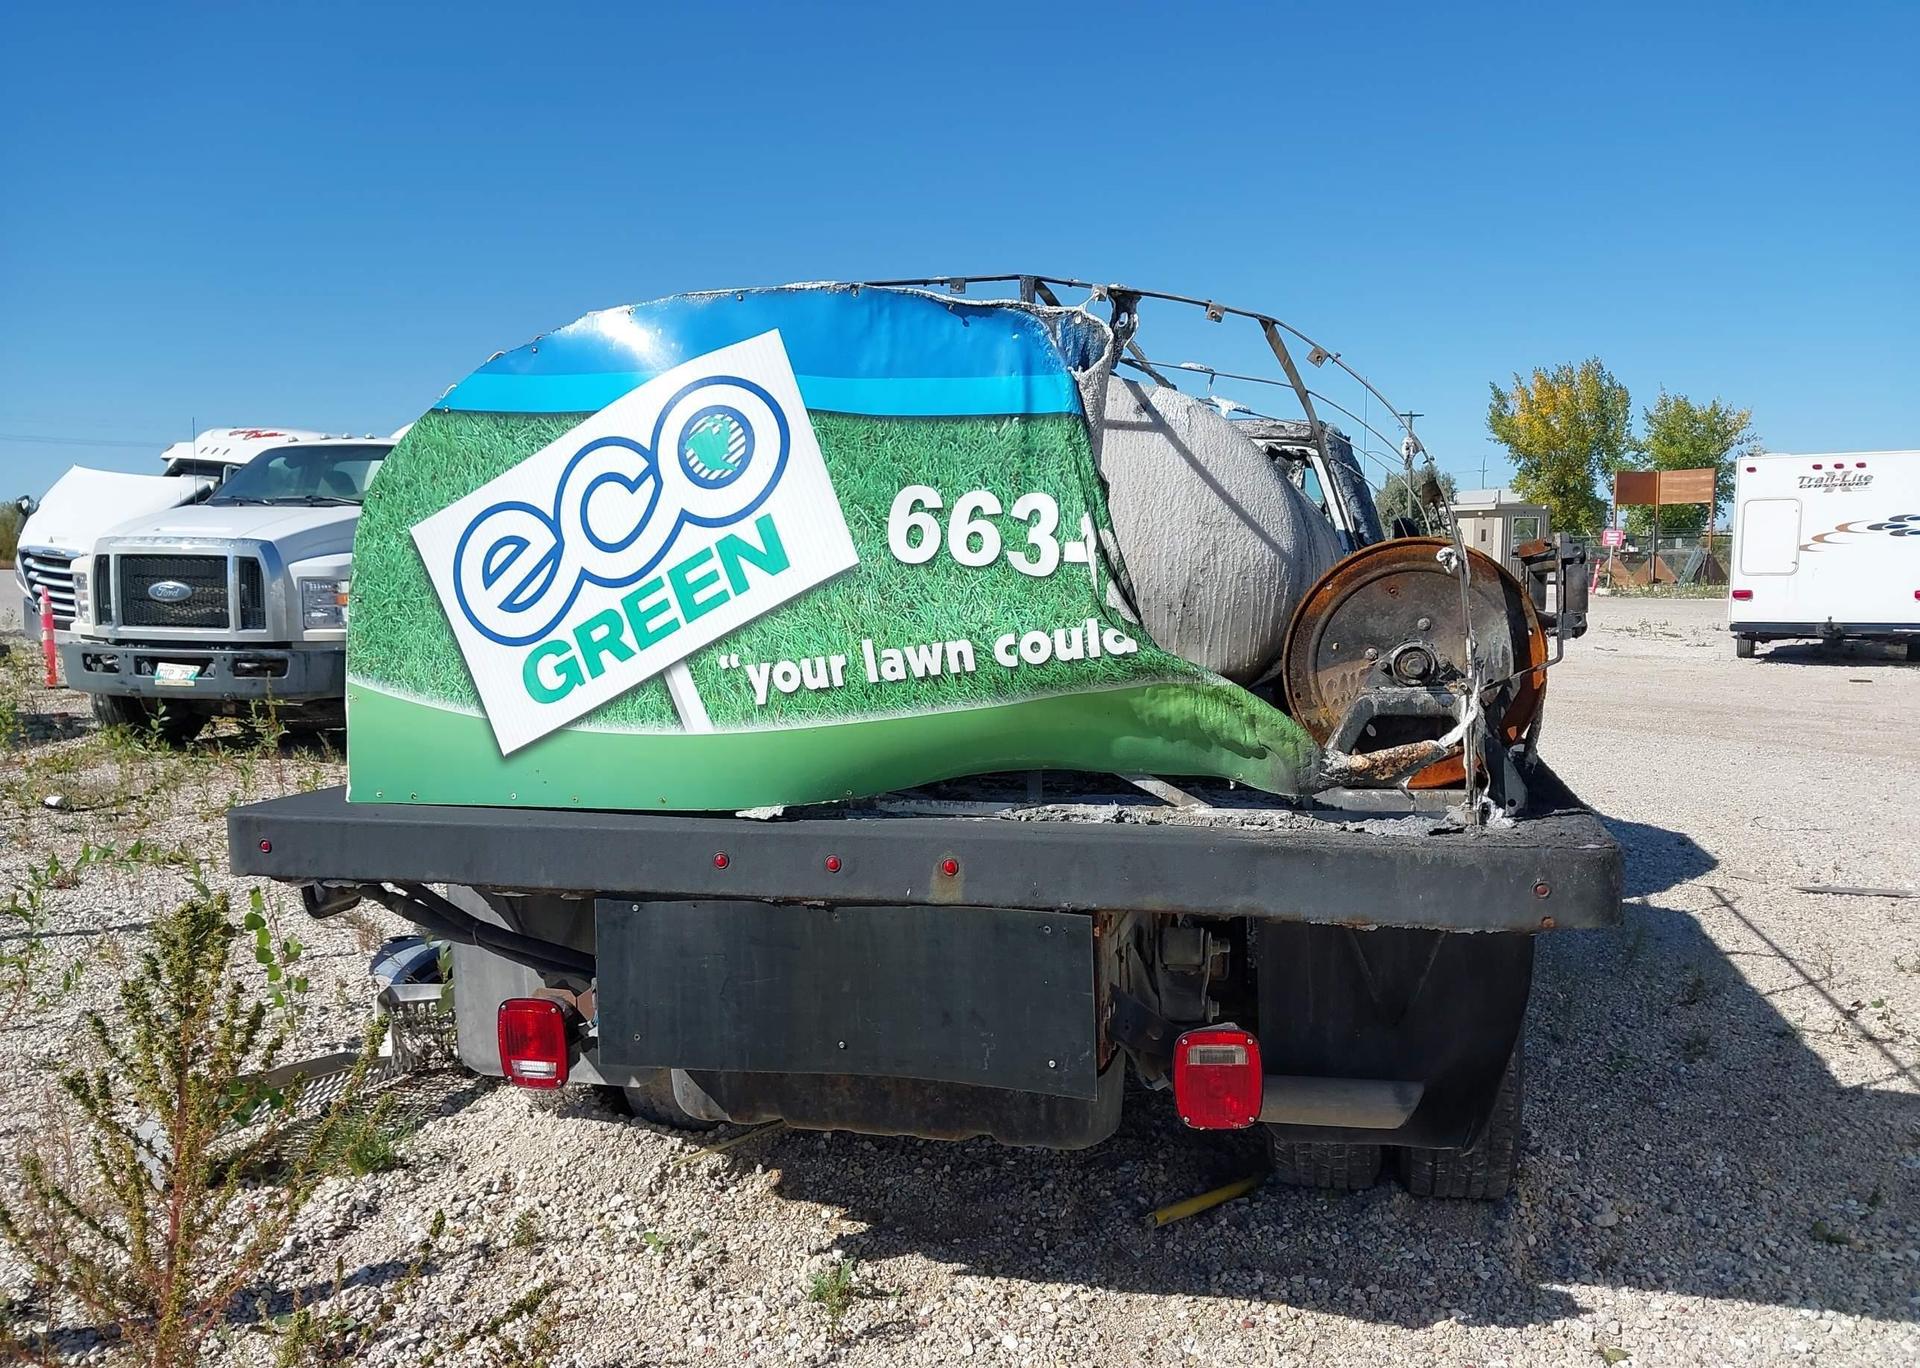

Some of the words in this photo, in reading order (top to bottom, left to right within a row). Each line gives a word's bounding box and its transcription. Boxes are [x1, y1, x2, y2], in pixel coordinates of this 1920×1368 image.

[453, 375, 790, 646] eco
[887, 484, 1098, 578] 663-
[156, 585, 179, 597] Ford
[522, 514, 790, 704] GREEN
[862, 639, 976, 683] lawn
